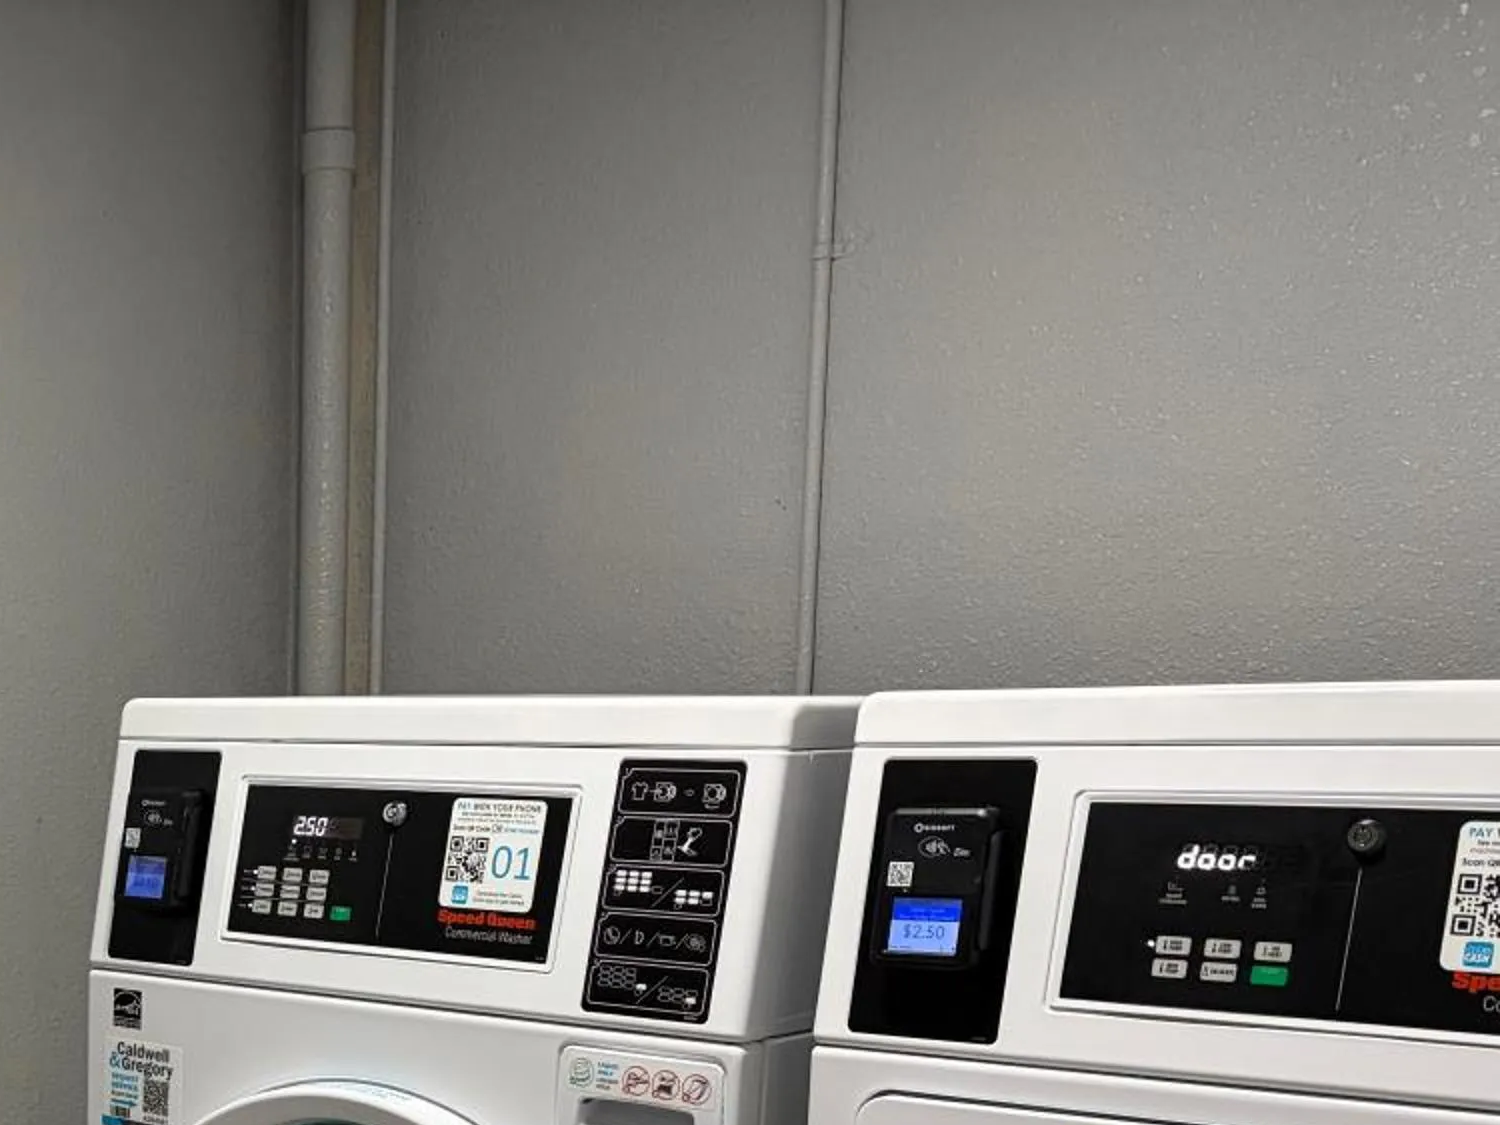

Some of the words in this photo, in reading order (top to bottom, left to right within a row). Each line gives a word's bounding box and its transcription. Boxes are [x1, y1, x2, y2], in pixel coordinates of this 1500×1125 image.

[491, 845, 530, 881] 01
[1177, 844, 1257, 870] door
[437, 909, 486, 925] Speed
[117, 1041, 170, 1063] Caldwell
